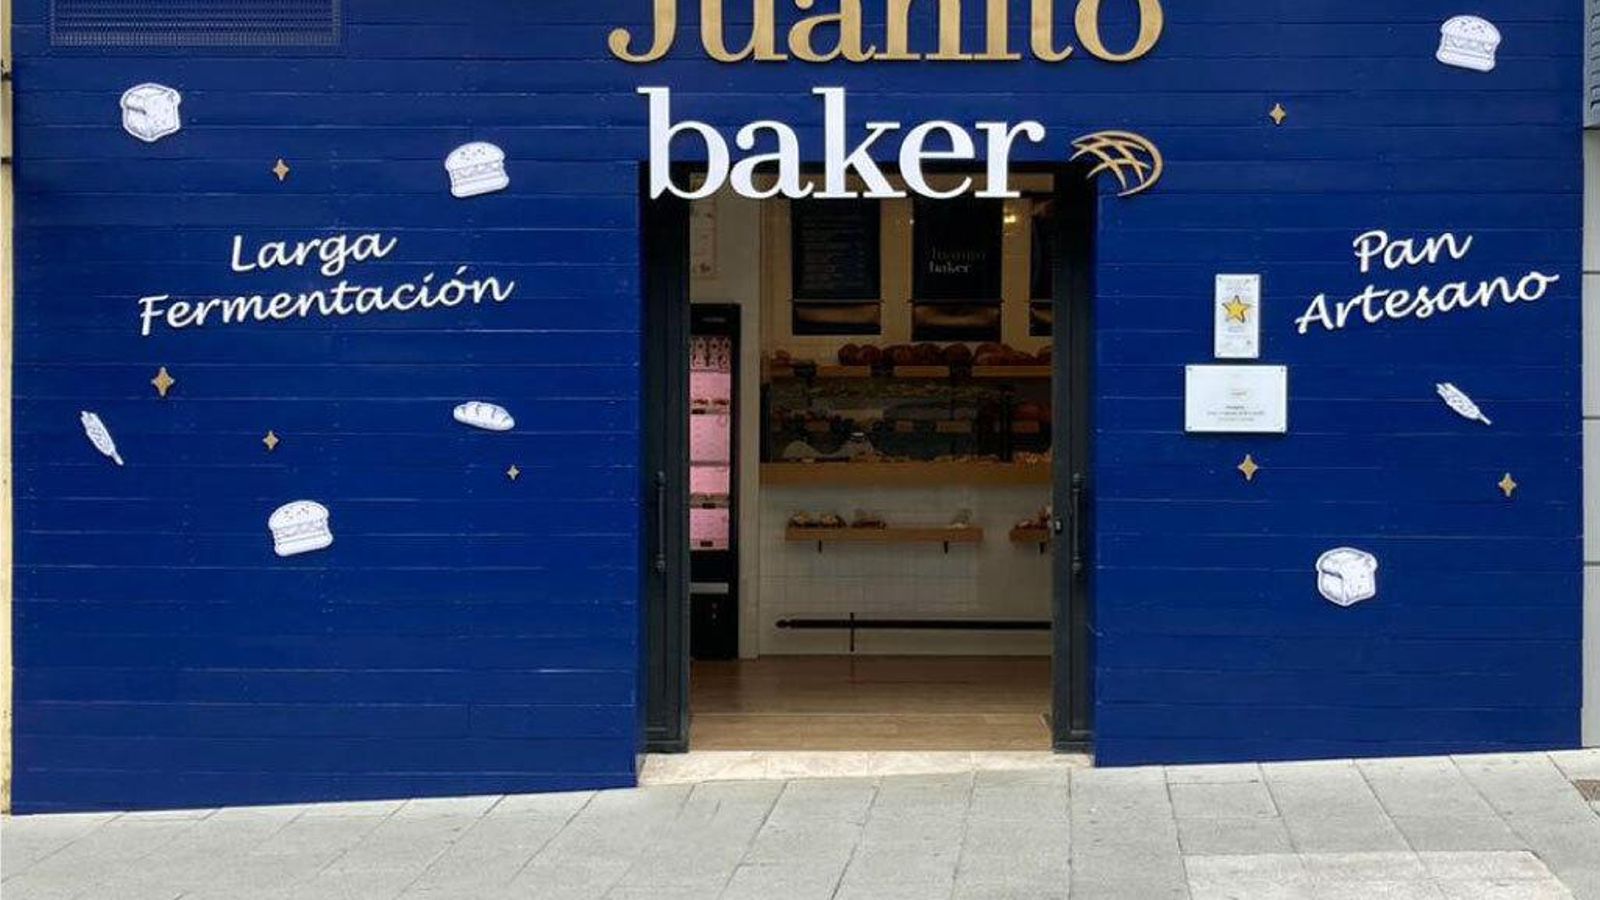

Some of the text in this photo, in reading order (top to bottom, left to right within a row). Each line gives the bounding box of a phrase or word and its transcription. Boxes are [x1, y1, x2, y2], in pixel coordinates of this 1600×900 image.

[637, 86, 1046, 200] baker
[231, 233, 397, 278] Larga
[1353, 230, 1473, 273] Pan
[138, 265, 516, 336] Fermentación
[1295, 270, 1560, 335] Artesano
